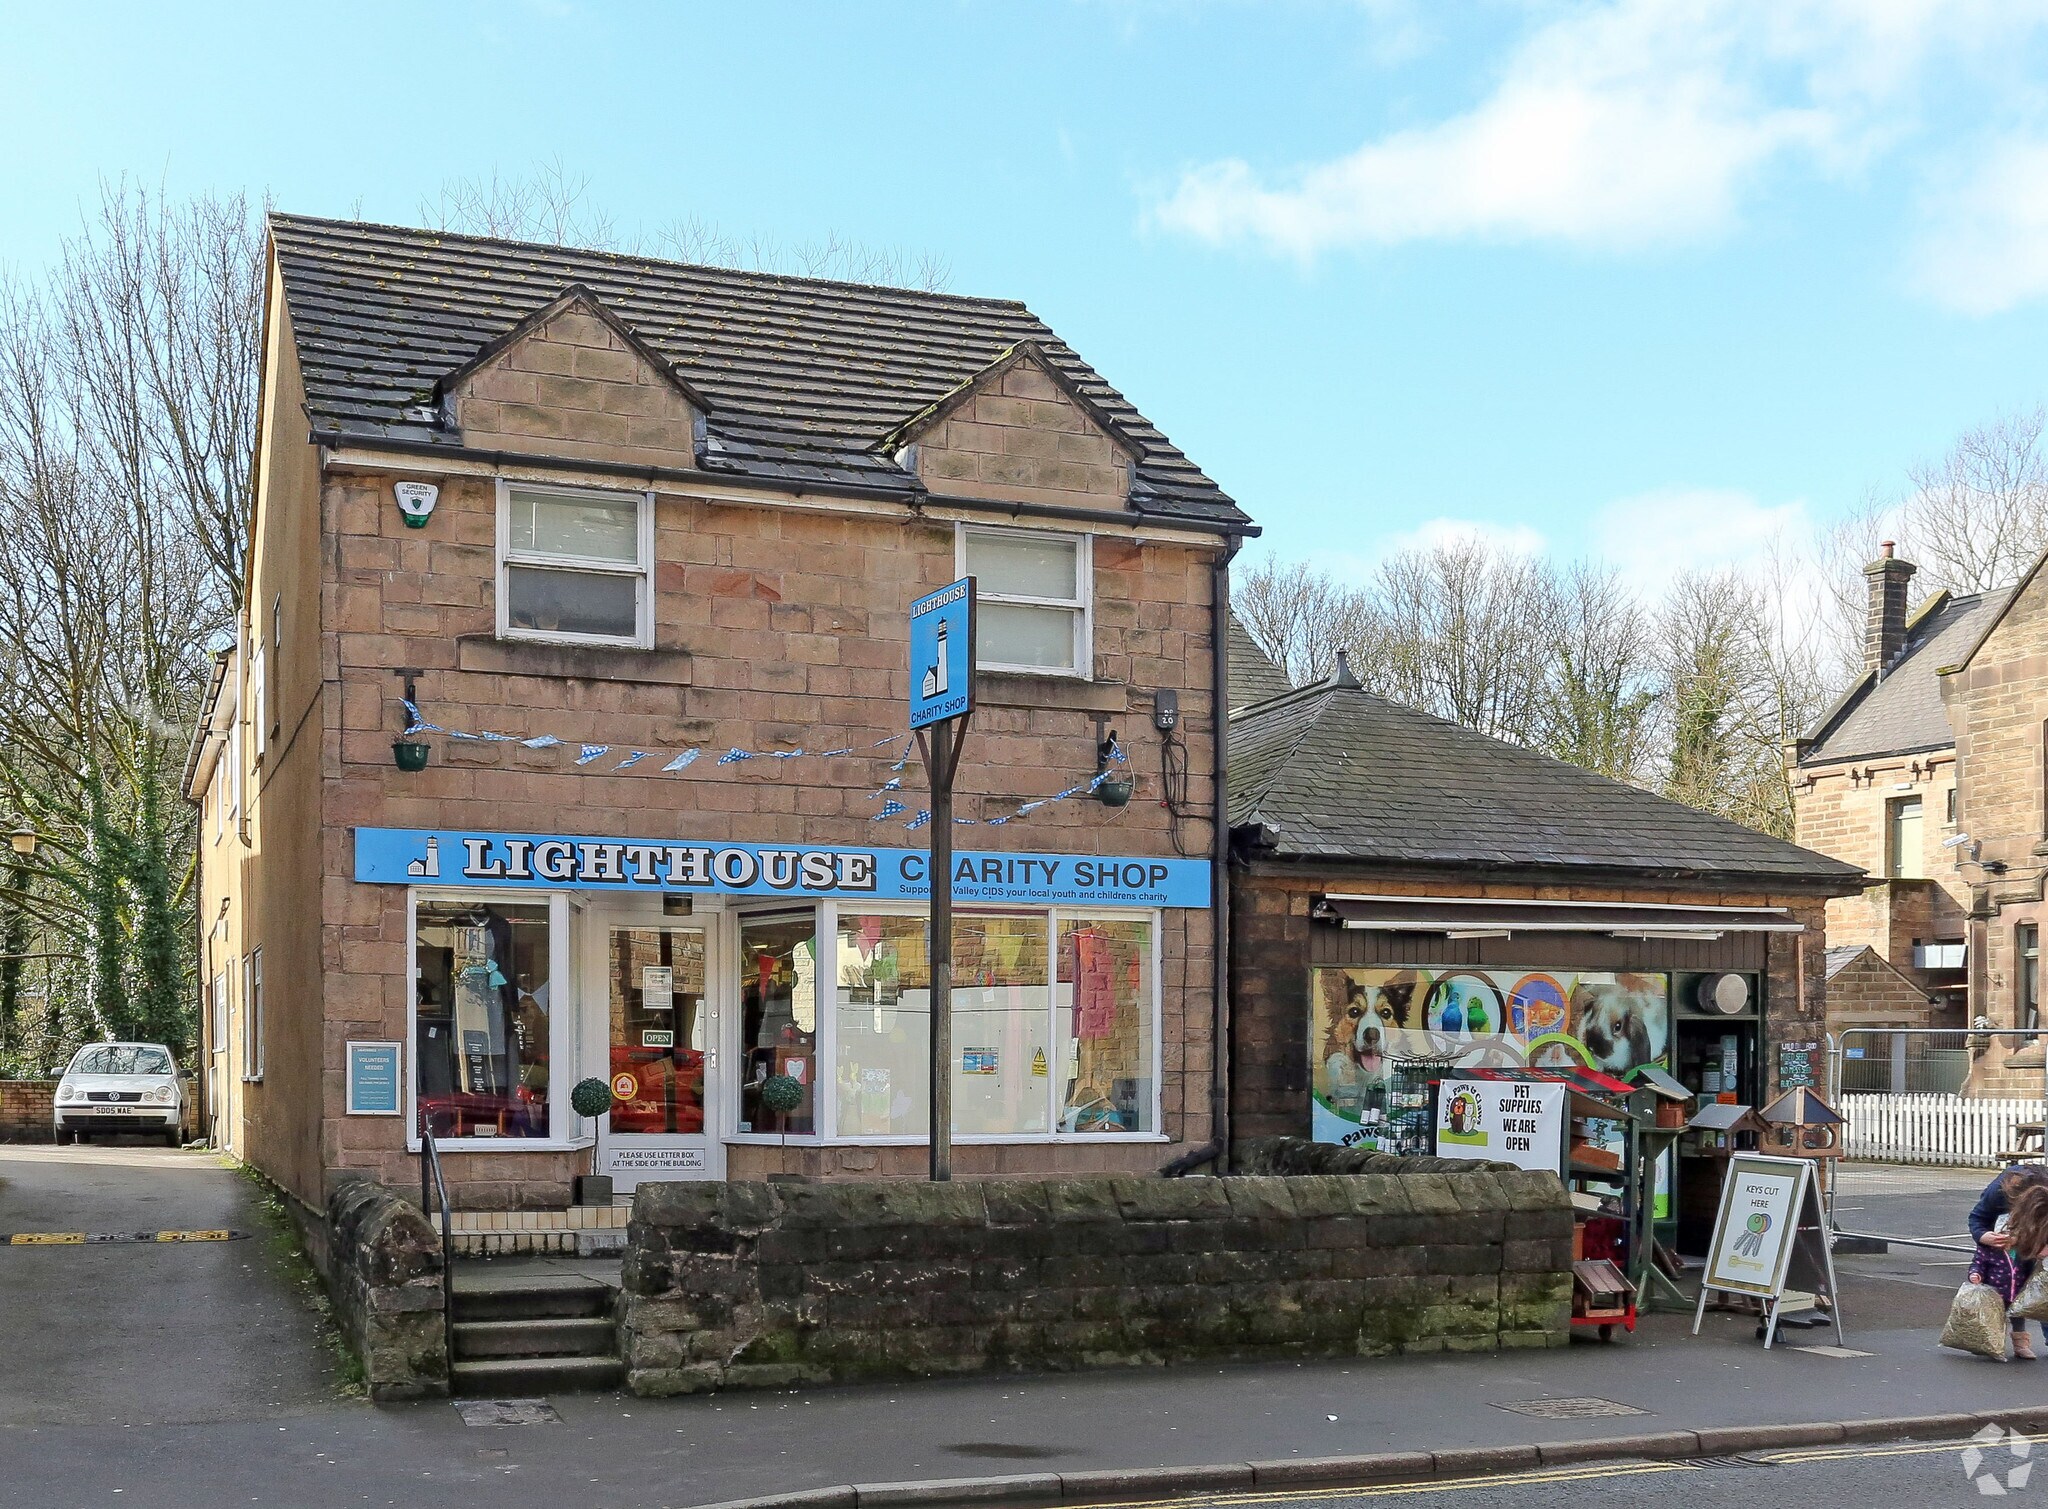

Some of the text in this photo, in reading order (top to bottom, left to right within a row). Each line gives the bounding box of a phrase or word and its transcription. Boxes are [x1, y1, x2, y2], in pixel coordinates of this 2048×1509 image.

[912, 584, 966, 619] LIGHTHOUSE
[911, 696, 966, 723] CHARITY SHOP
[463, 838, 877, 891] LIGHTHOUSE
[900, 855, 1168, 889] CARITY SHOP
[899, 884, 1168, 902] Suppo Valley CIDS your local youth and childrens charity
[646, 1034, 670, 1042] OPEN
[1514, 1084, 1530, 1098] PET
[1452, 1084, 1470, 1096] Paws
[1470, 1086, 1477, 1095] &
[1475, 1093, 1483, 1125] Claws
[1499, 1099, 1543, 1115] SUPPLIES.
[1503, 1118, 1537, 1134] WE ARE
[1506, 1137, 1530, 1151] OPEN
[619, 1151, 695, 1159] PLEASE USE LETTER BOX
[1746, 1185, 1780, 1196] KEYS CUT
[1751, 1199, 1770, 1209] HERE
